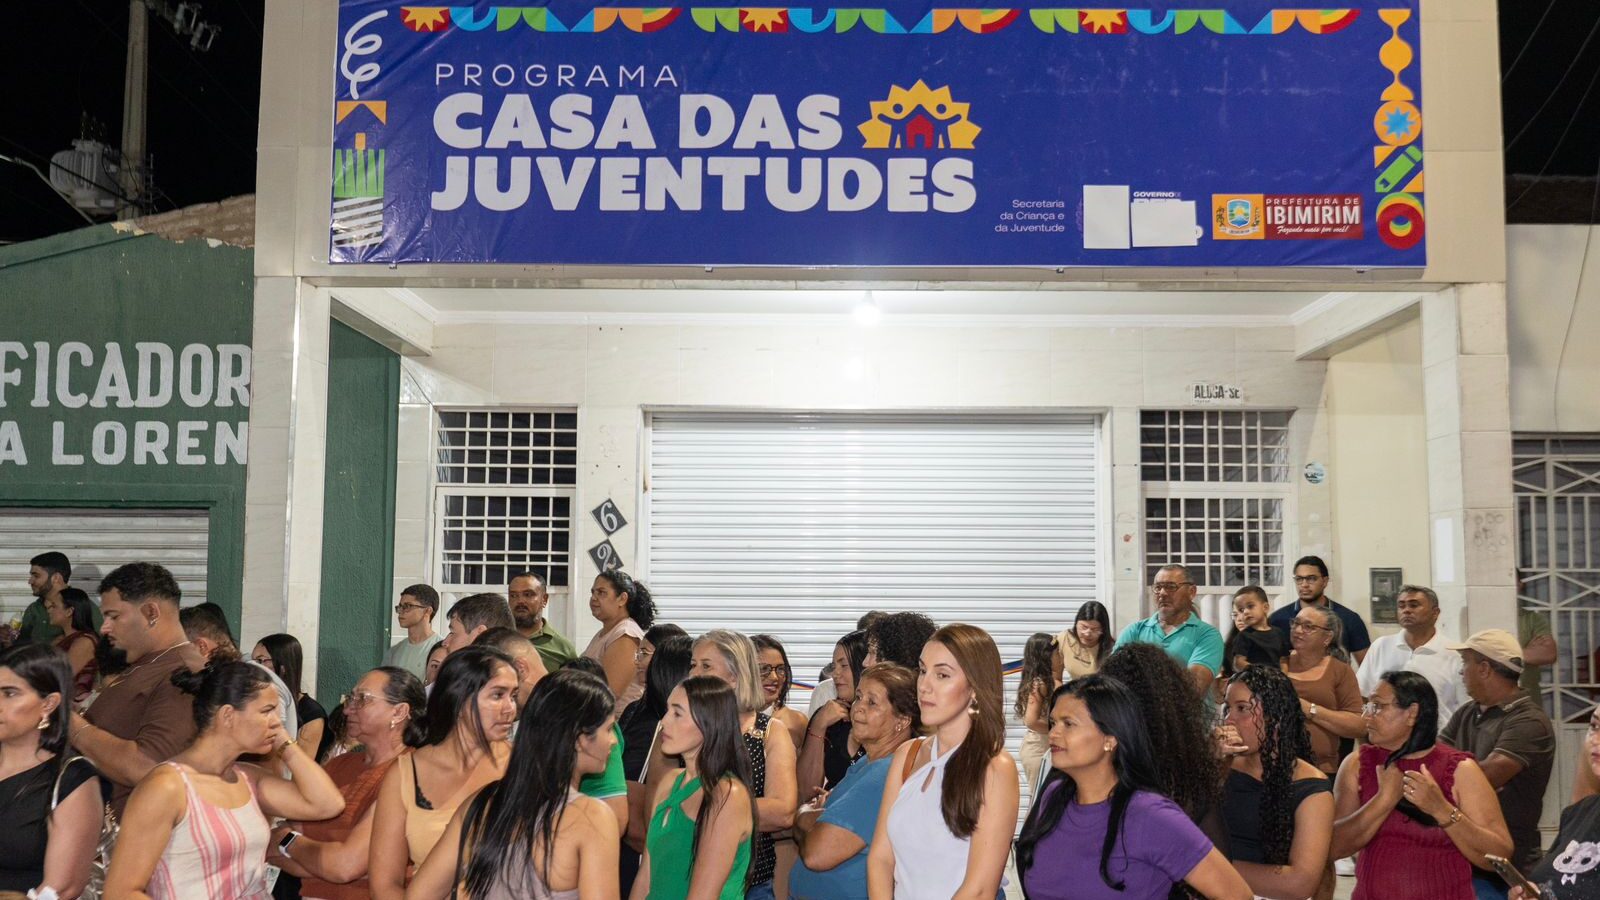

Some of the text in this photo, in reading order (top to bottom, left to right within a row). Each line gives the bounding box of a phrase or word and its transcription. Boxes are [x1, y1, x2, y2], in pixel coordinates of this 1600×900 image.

[435, 63, 679, 87] PROGRAMA
[432, 93, 843, 150] CASA DAS
[430, 156, 977, 213] JUVENTUDES
[1012, 199, 1065, 209] Secretaria
[1265, 197, 1360, 206] PREFEITURA DE
[1000, 211, 1065, 222] da Criança e
[1266, 205, 1361, 225] IBIMIRIM
[994, 223, 1065, 233] da Juventude
[1320, 227, 1332, 235] por
[0, 341, 252, 408] FICADOR
[0, 421, 248, 465] A LOREN
[600, 501, 618, 532] 6
[597, 543, 617, 572] 2
